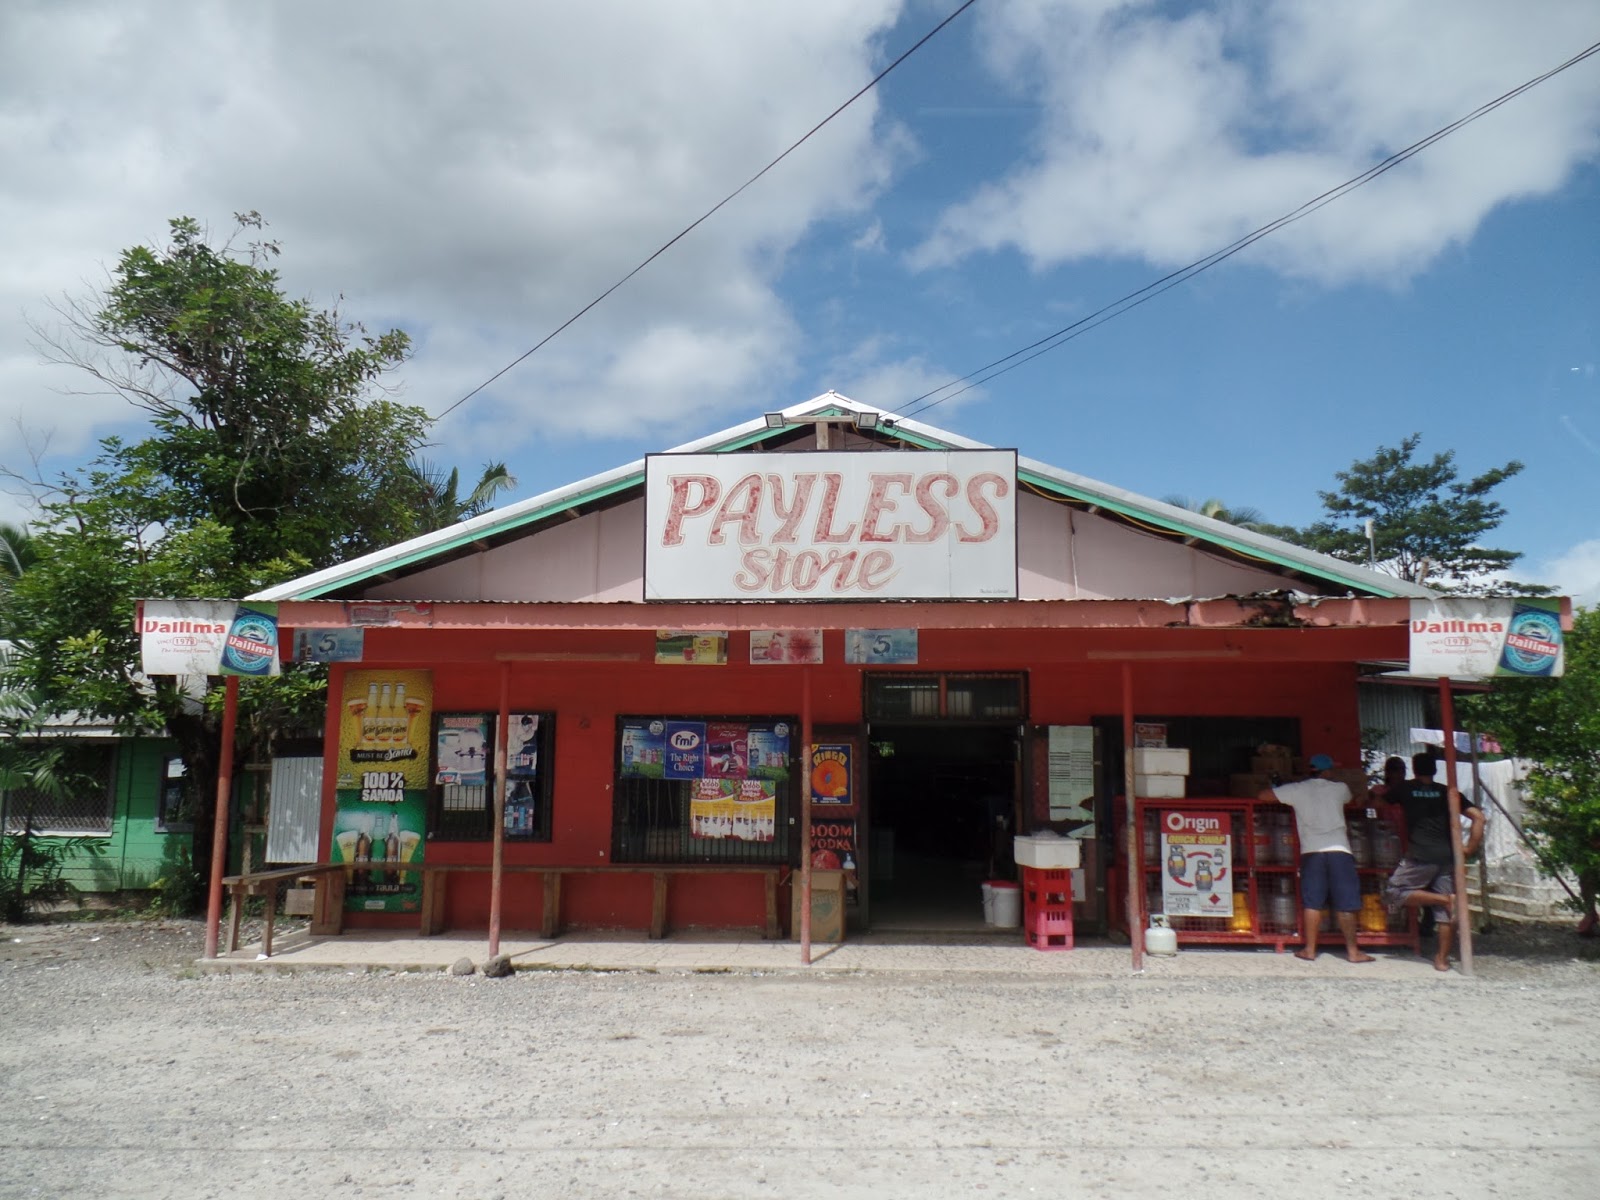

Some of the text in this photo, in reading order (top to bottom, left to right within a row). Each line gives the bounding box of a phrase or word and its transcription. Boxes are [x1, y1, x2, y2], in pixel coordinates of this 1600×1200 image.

[661, 471, 1009, 547] PAYLESS
[733, 546, 903, 593] Store
[228, 636, 274, 656] Vailima
[1507, 634, 1558, 655] Vailima
[675, 734, 696, 746] fmf
[671, 753, 700, 764] The Right
[673, 762, 695, 772] Choice
[362, 771, 404, 789] 100%
[361, 789, 404, 801] SAMOA
[1167, 812, 1219, 833] Origin
